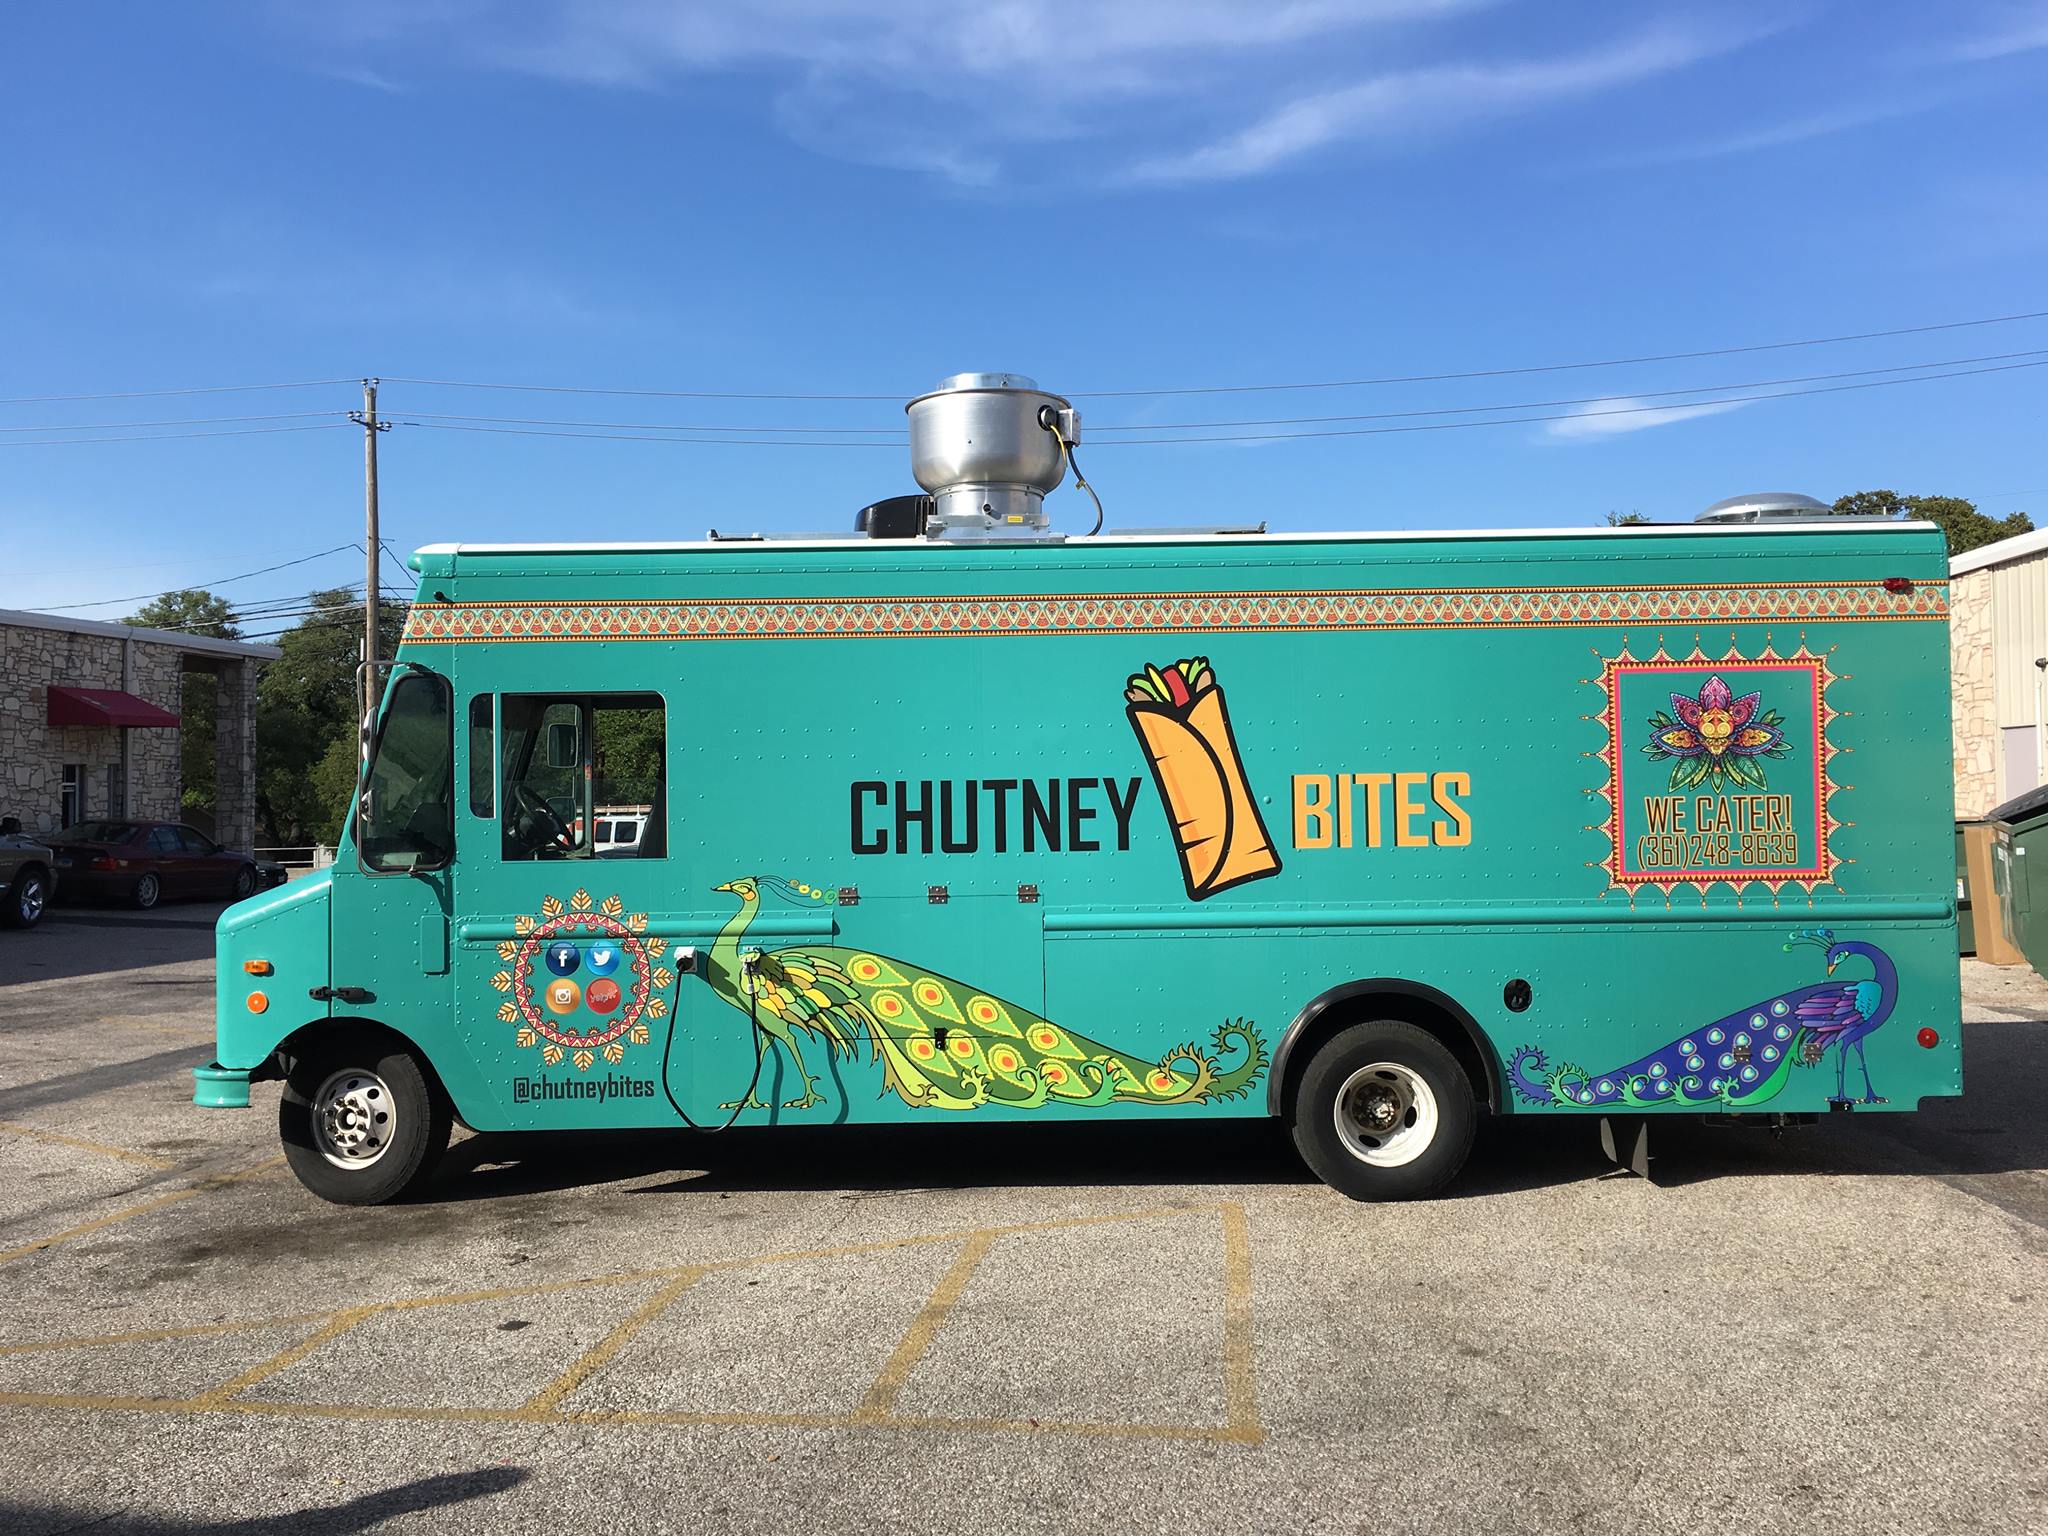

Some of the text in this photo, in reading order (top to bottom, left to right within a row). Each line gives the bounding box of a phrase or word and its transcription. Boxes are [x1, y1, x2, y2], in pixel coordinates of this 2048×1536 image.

[851, 771, 1472, 855] CHUTNEY BITES
[1645, 794, 1794, 834] WE CATER!
[1637, 834, 1798, 870] (361)248-8639
[558, 949, 568, 967] f
[513, 1072, 655, 1104] @chutneybites
